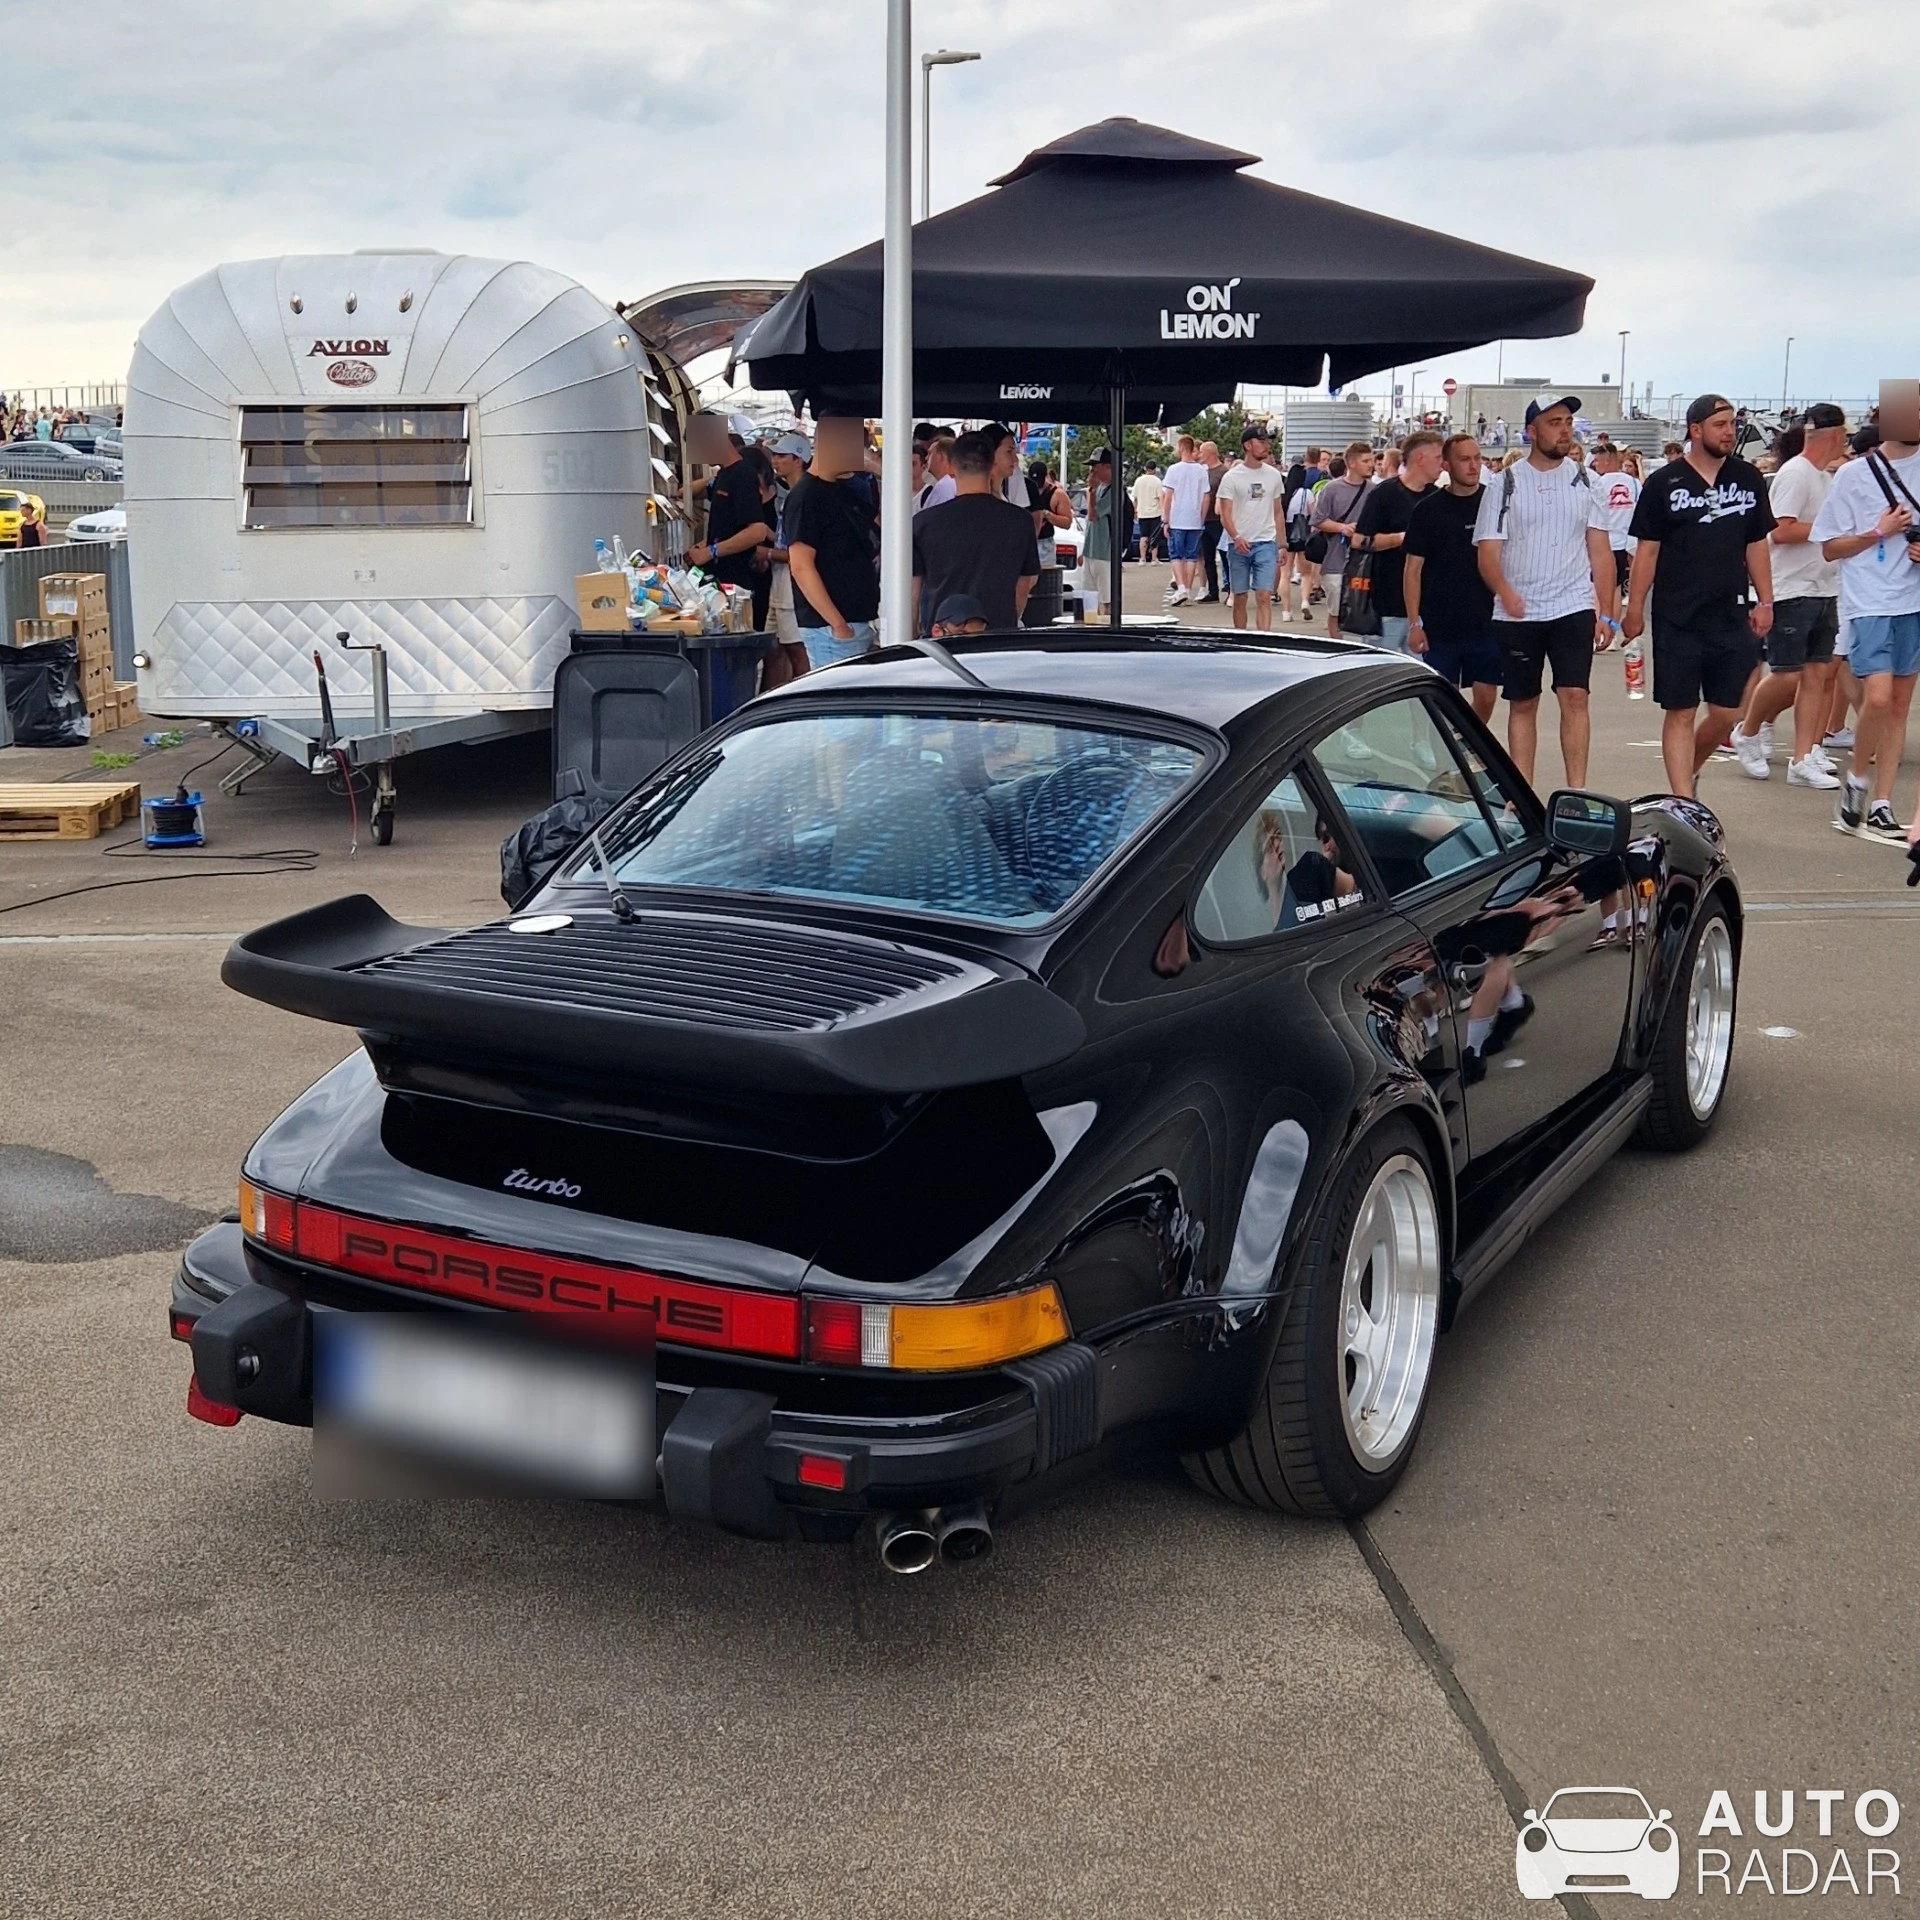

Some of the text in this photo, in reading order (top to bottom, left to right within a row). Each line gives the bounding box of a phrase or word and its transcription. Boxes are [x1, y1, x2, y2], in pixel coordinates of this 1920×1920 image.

[1186, 284, 1232, 312] ON
[1160, 308, 1256, 339] LEMON
[306, 339, 391, 357] AVION
[999, 383, 1051, 400] LEMON
[1669, 482, 1757, 516] Broklyn
[502, 1167, 582, 1198] turbo
[345, 1232, 724, 1334] PORSCHE
